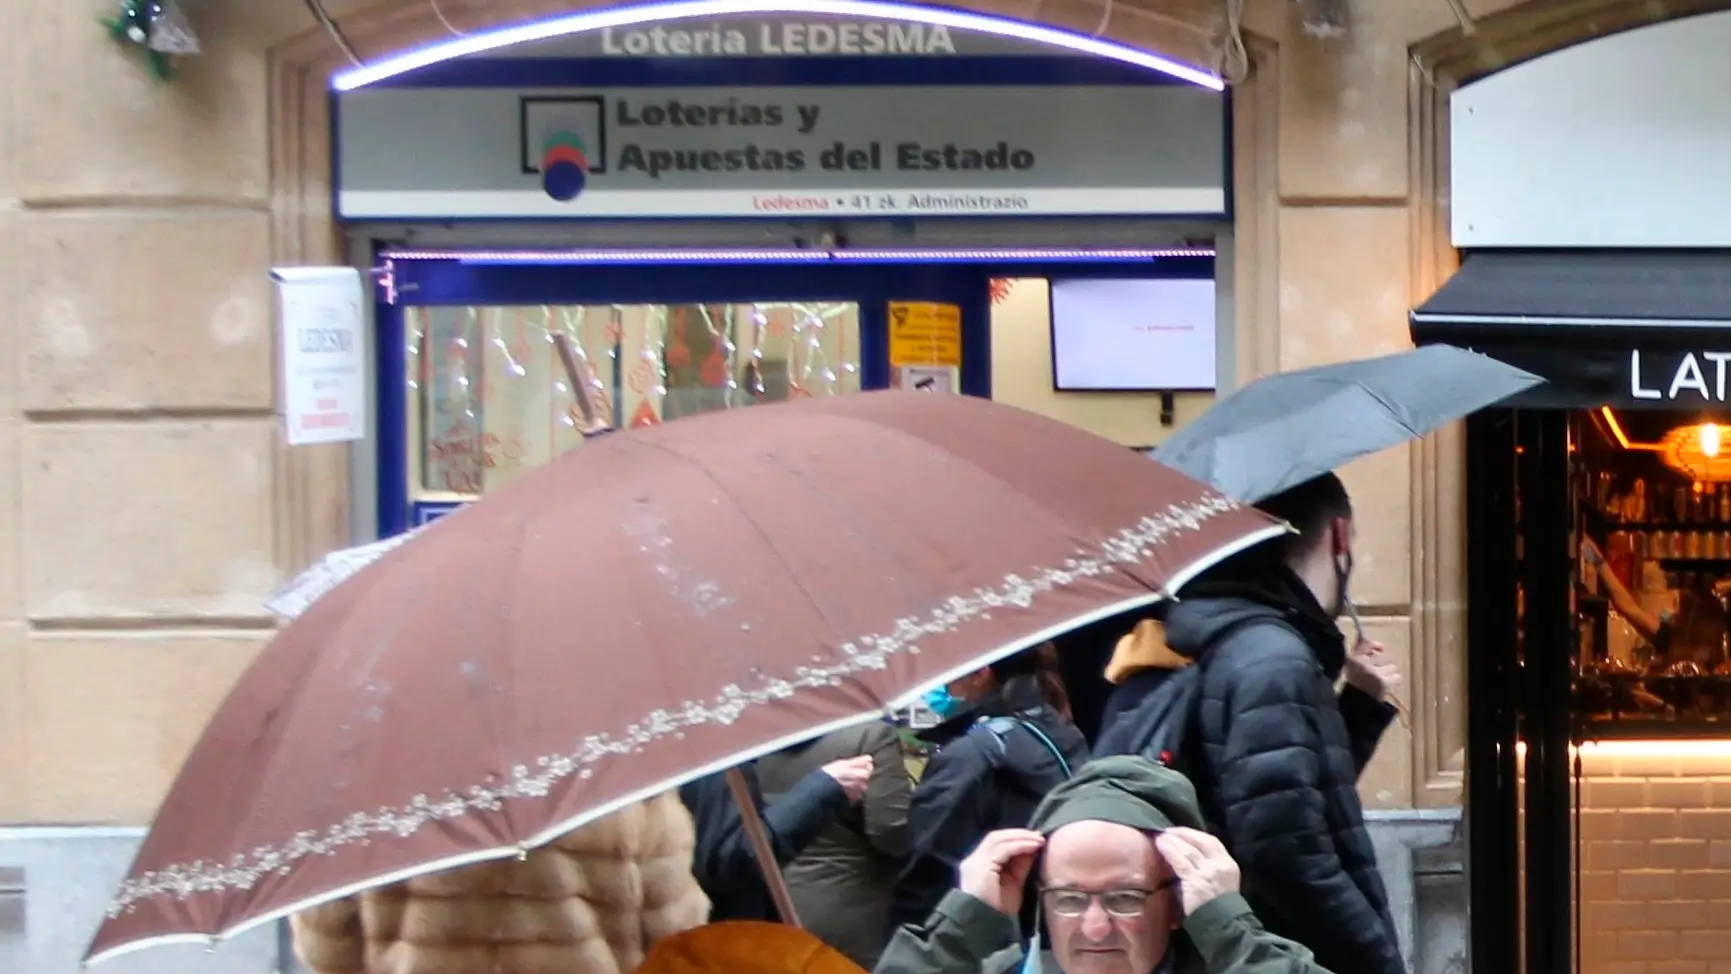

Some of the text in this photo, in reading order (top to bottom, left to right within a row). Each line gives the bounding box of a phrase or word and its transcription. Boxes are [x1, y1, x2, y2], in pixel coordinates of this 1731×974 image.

[761, 22, 957, 55] LEDESMA
[797, 105, 820, 133] y
[617, 142, 1035, 178] Apuestas del Estado
[753, 195, 830, 210] Ledesma
[907, 194, 1028, 210] Administrazio
